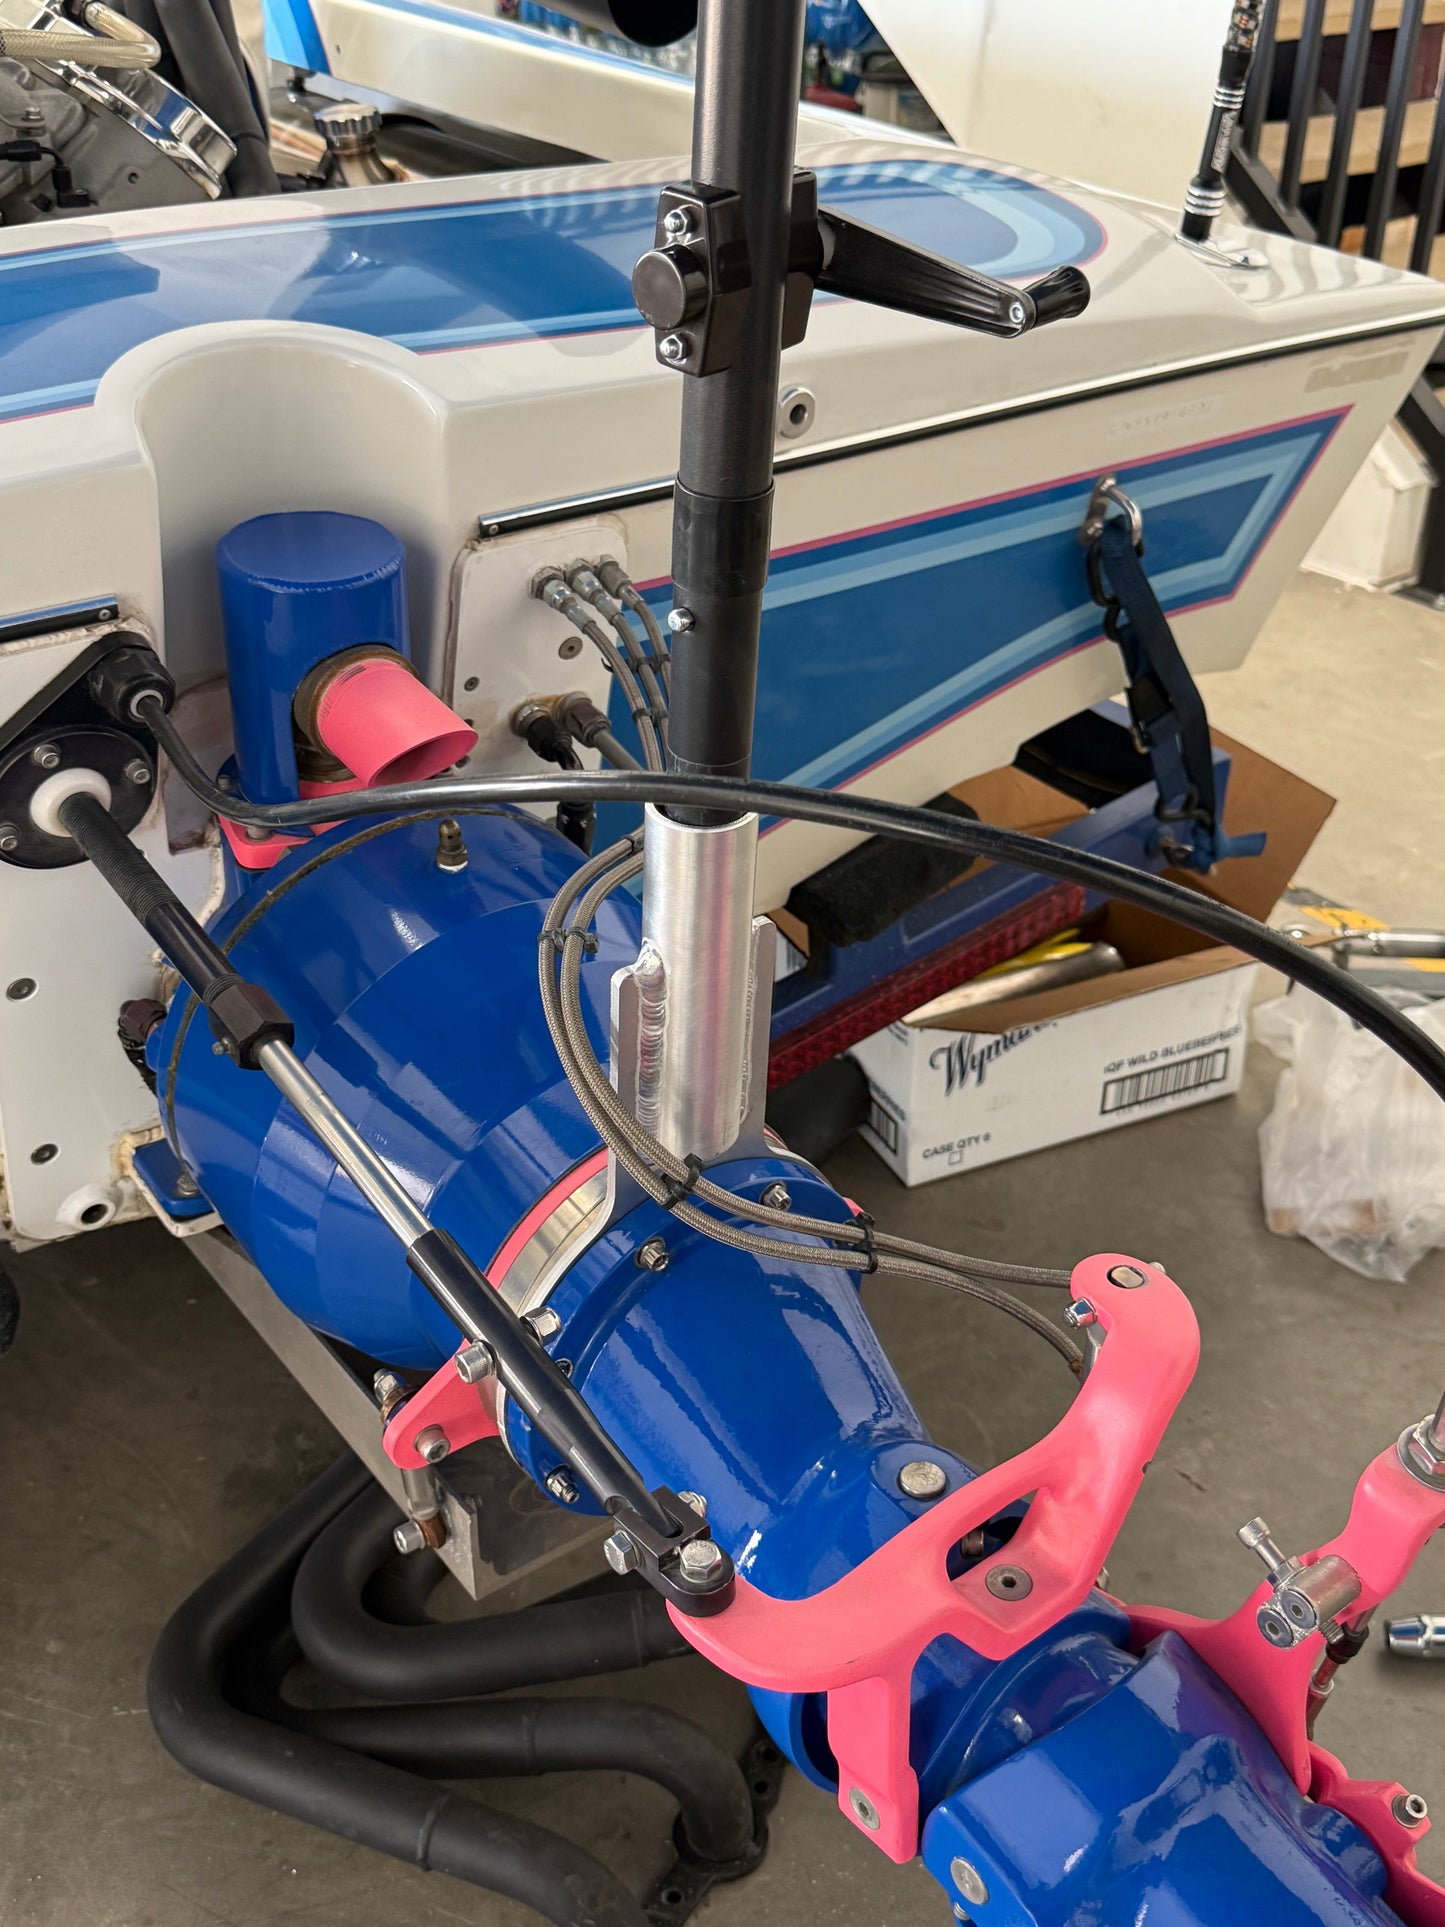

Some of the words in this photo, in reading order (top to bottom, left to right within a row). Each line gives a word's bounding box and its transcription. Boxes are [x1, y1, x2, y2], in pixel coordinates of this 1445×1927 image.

[1127, 1050, 1158, 1068] WILD
[922, 1141, 954, 1159] CASE
[957, 1134, 981, 1149] QTY
